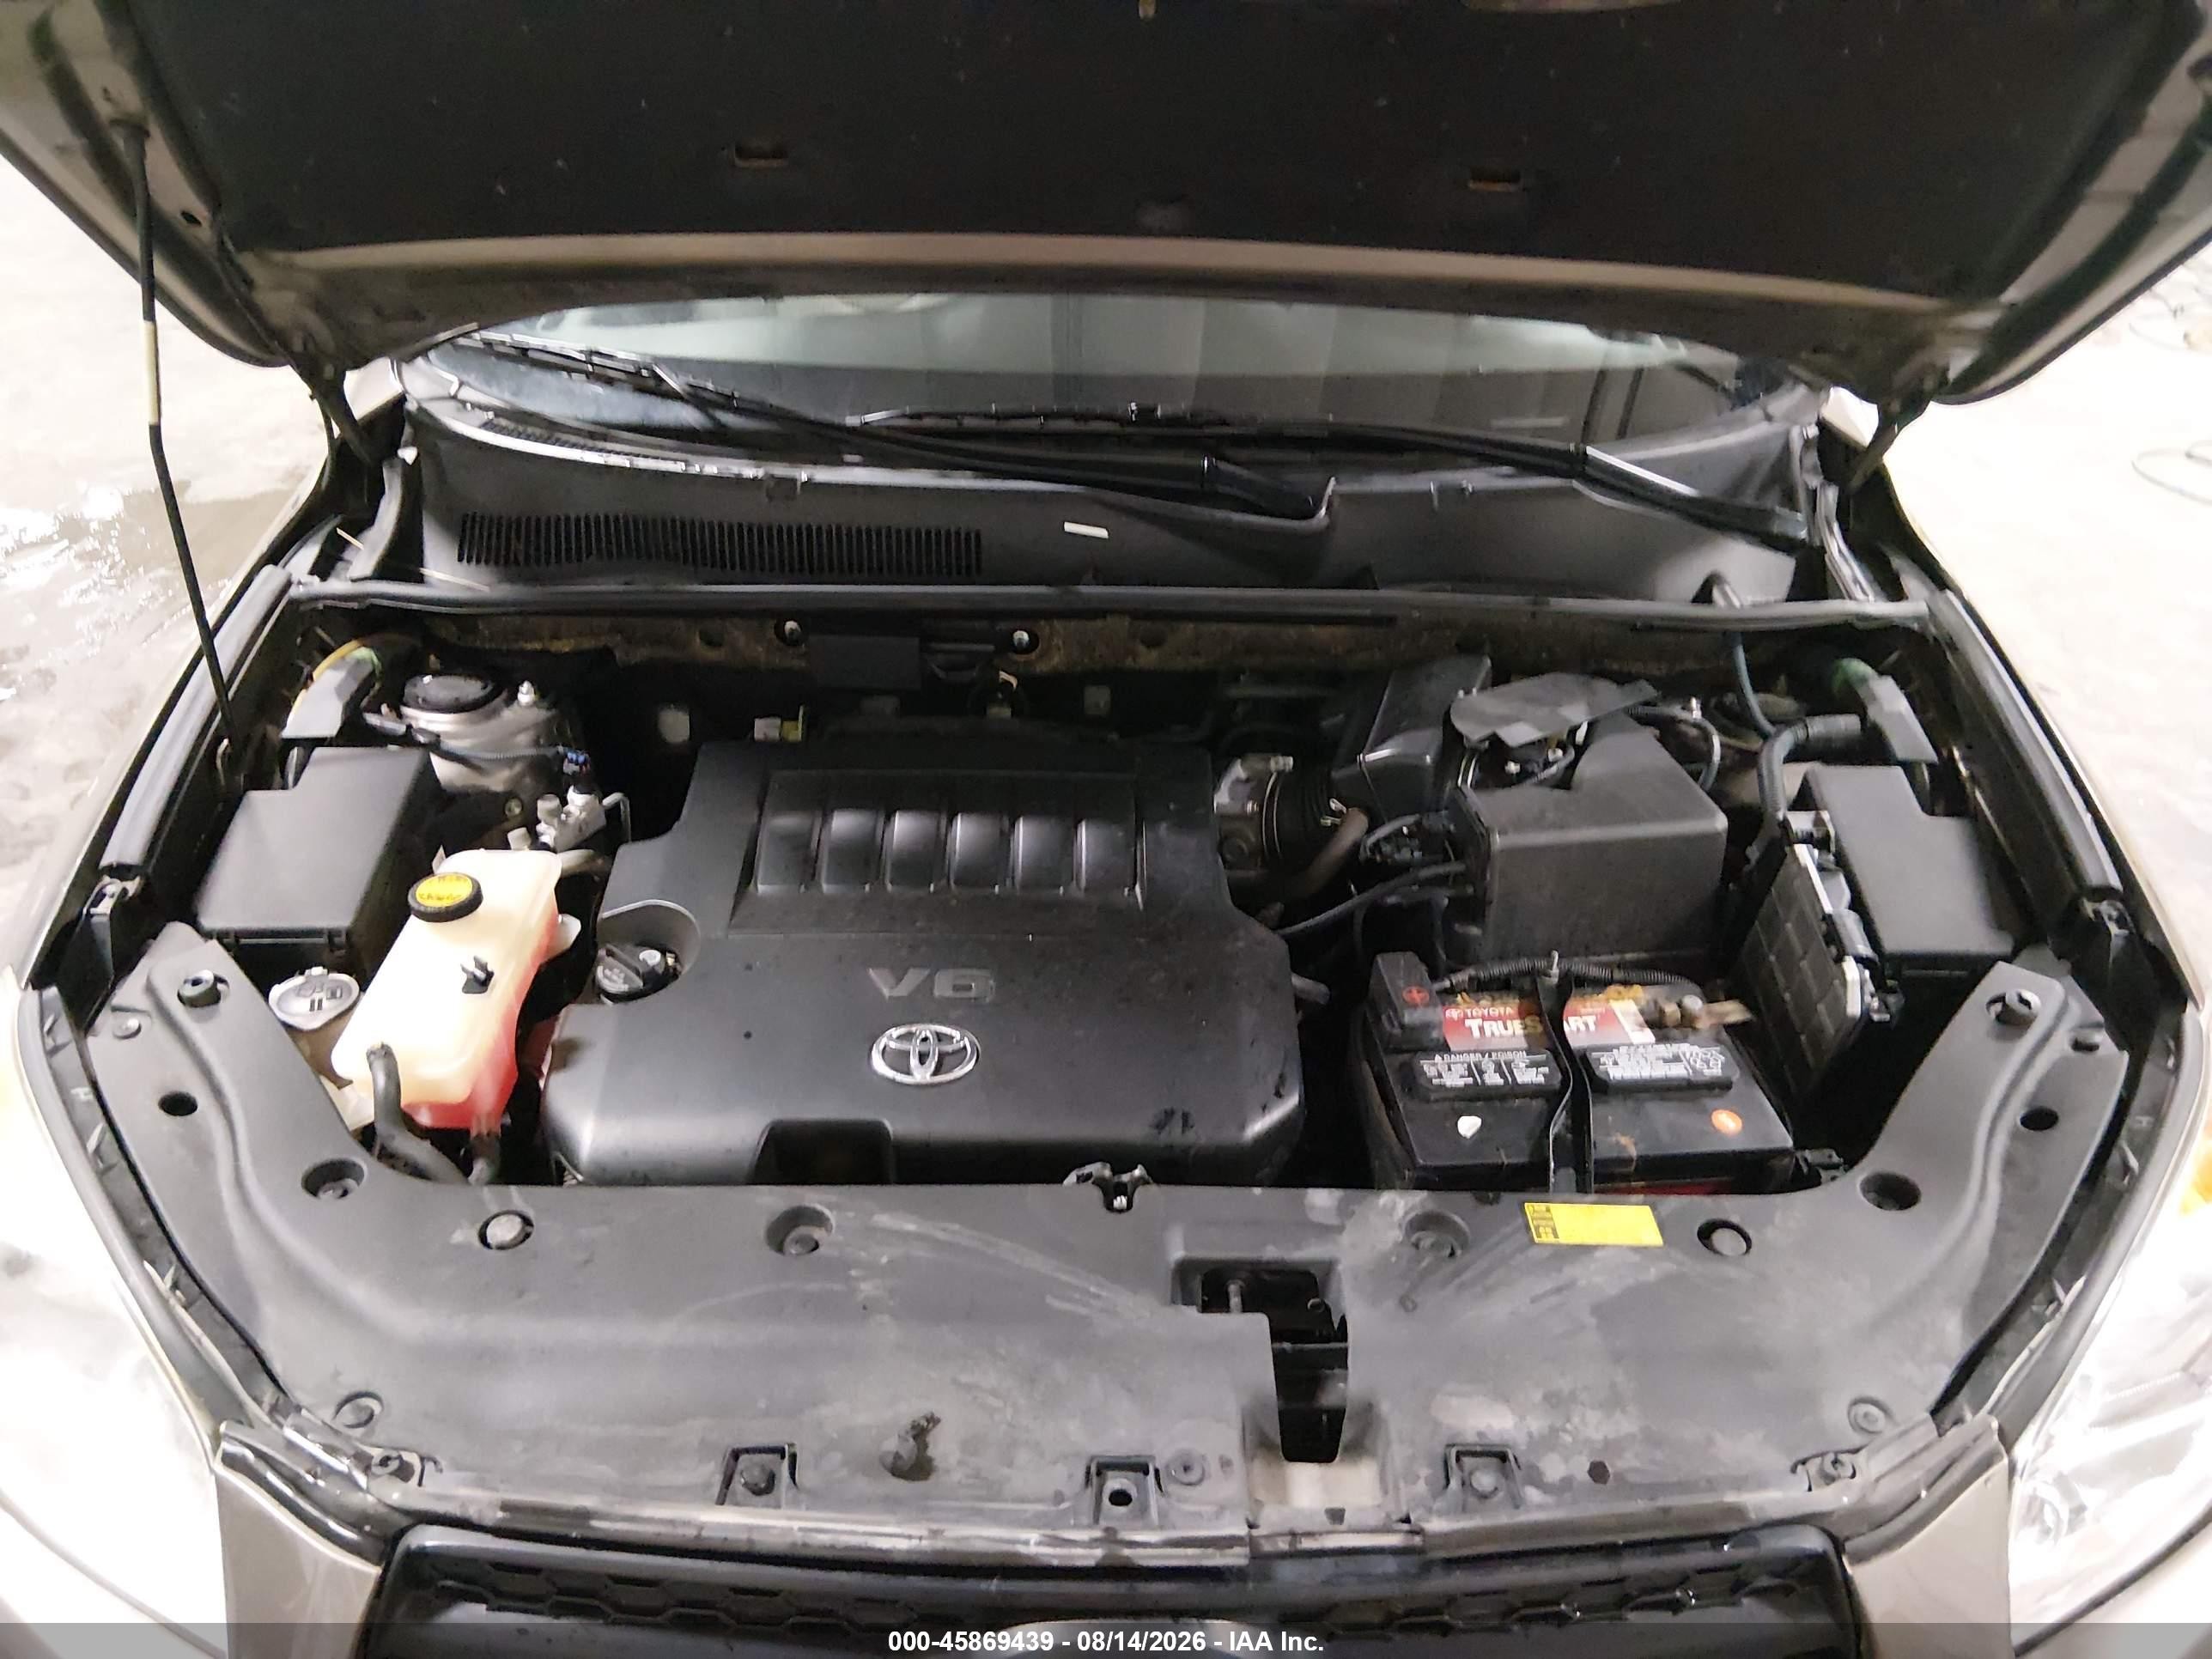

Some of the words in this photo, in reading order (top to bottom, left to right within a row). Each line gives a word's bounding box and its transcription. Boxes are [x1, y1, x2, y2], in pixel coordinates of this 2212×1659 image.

[866, 966, 996, 1003] V6
[1464, 1006, 1514, 1018] TOYOTA
[1464, 1015, 1596, 1039] TRUESART
